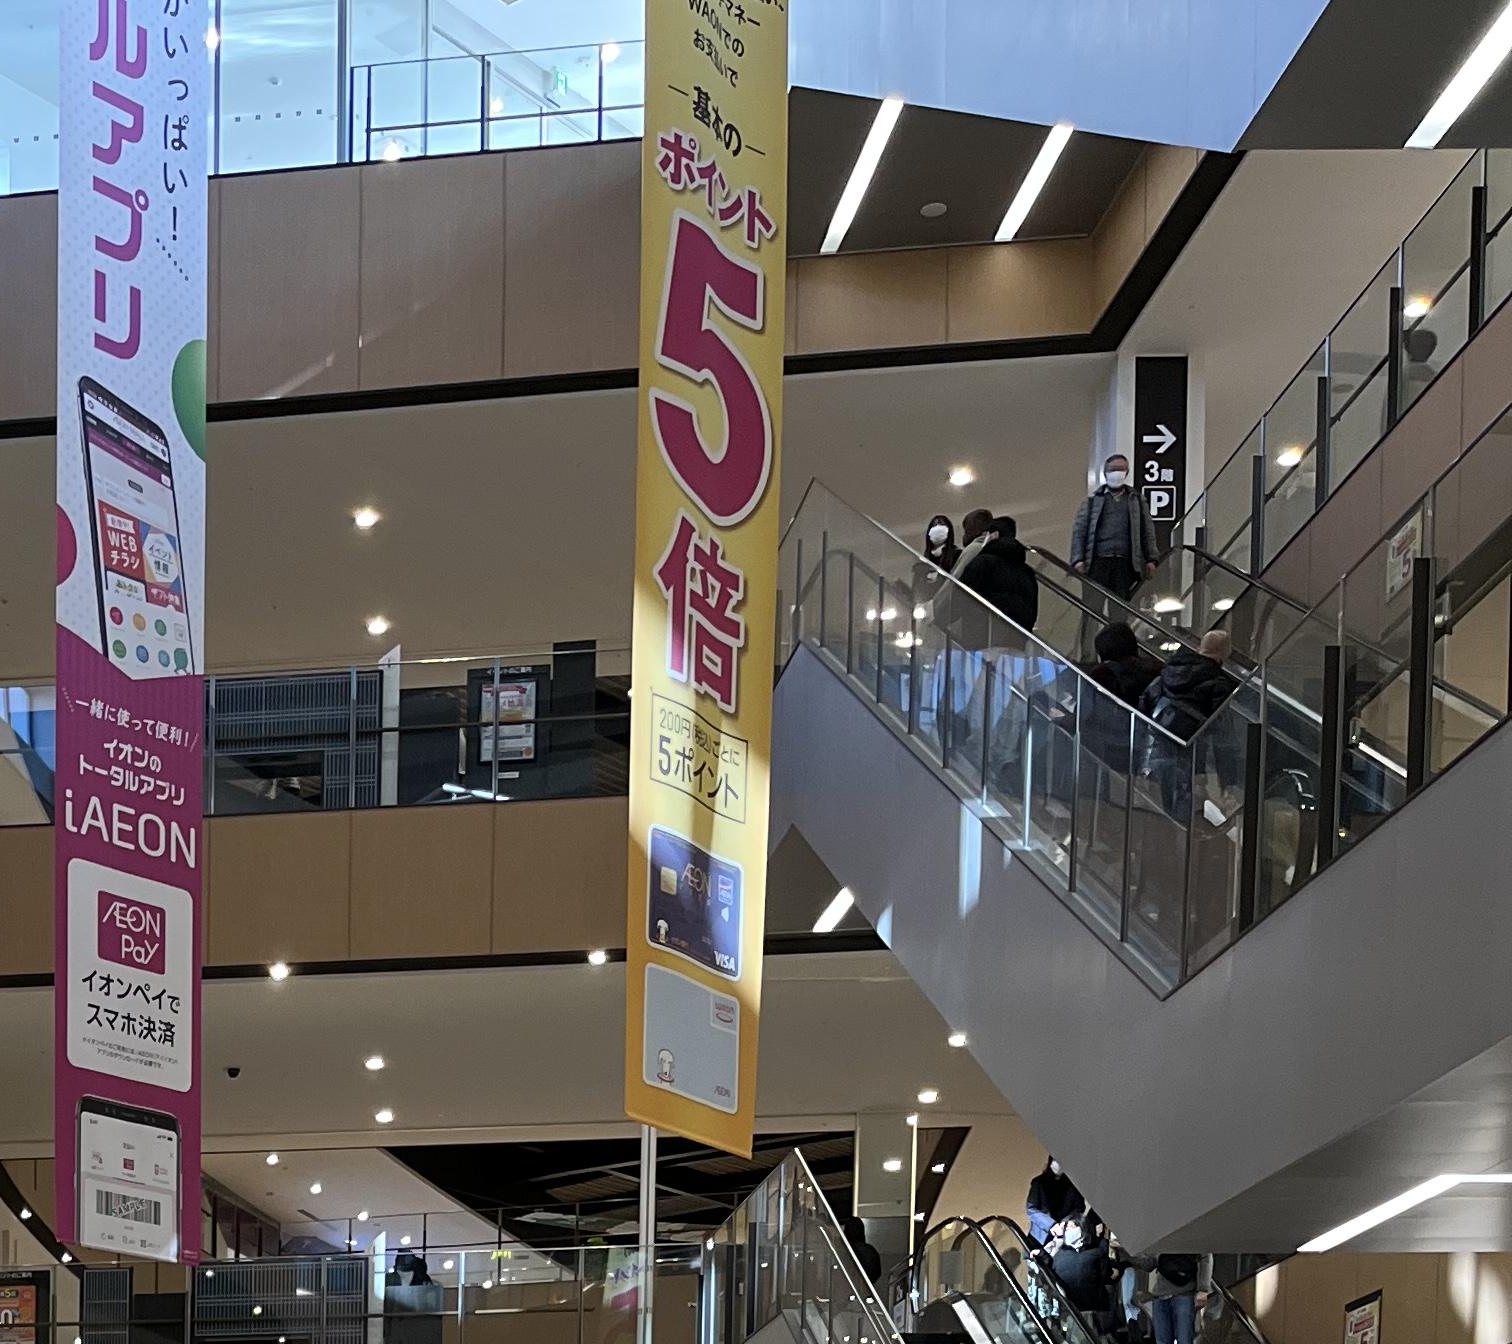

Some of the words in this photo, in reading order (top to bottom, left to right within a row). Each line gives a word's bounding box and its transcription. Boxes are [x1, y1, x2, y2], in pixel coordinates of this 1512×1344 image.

[692, 86, 742, 157] 基本の
[658, 131, 773, 244] ポイント
[107, 530, 138, 552] WEB
[110, 551, 139, 570] チラシ
[104, 739, 162, 773] イオンの
[658, 735, 739, 808] 5ポイント
[80, 754, 185, 806] トータルアプリ
[65, 788, 196, 869] iAEON
[714, 950, 736, 972] VISA
[82, 970, 181, 1014] イオンペイで
[87, 1002, 176, 1047] スマホ決済
[111, 1198, 147, 1217] SAMPLE
